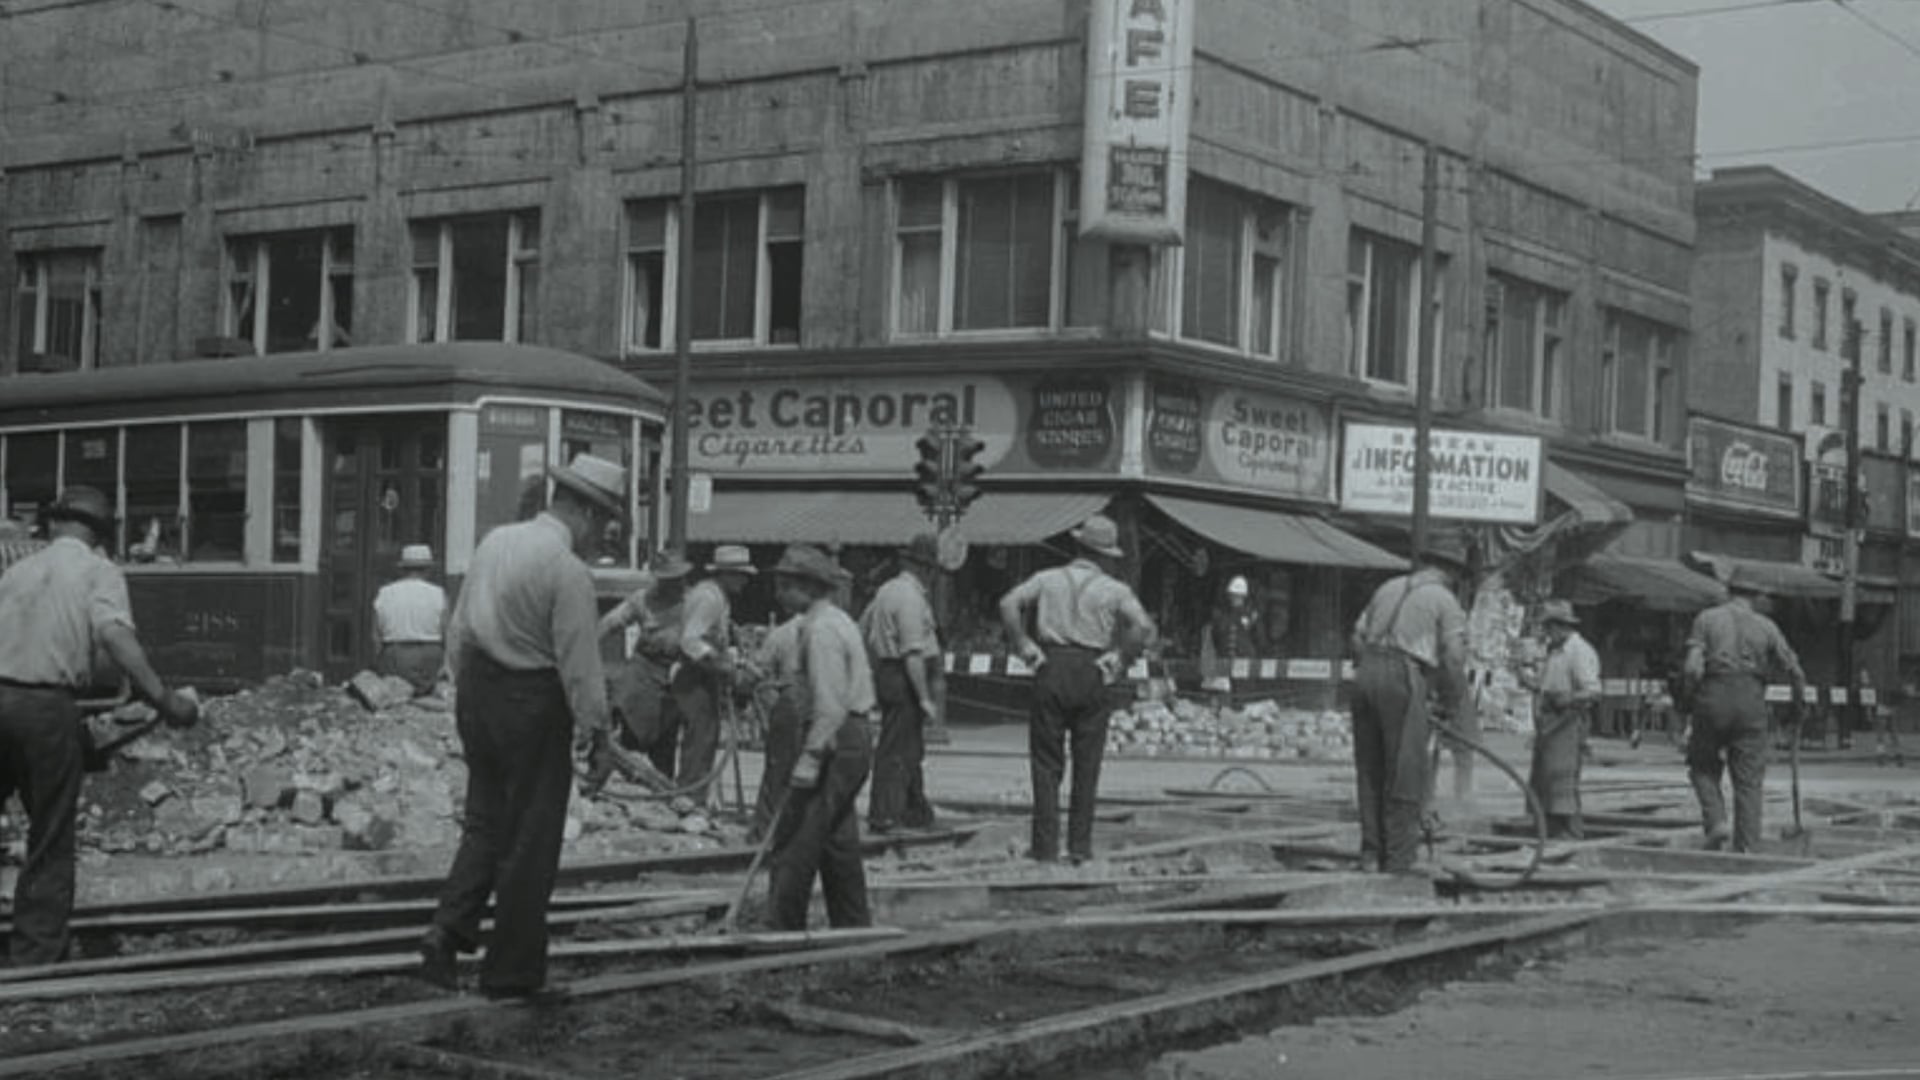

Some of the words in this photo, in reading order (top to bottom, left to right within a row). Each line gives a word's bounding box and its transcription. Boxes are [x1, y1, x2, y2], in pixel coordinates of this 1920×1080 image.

[668, 391, 756, 429] eet
[769, 384, 976, 436] Caporal
[1040, 392, 1102, 408] UNITED
[1232, 398, 1309, 434] Sweet
[1043, 410, 1098, 426] CIGAR
[698, 432, 867, 466] Cigarettes
[1221, 420, 1317, 458] Caporal
[1391, 433, 1495, 451] BREAU
